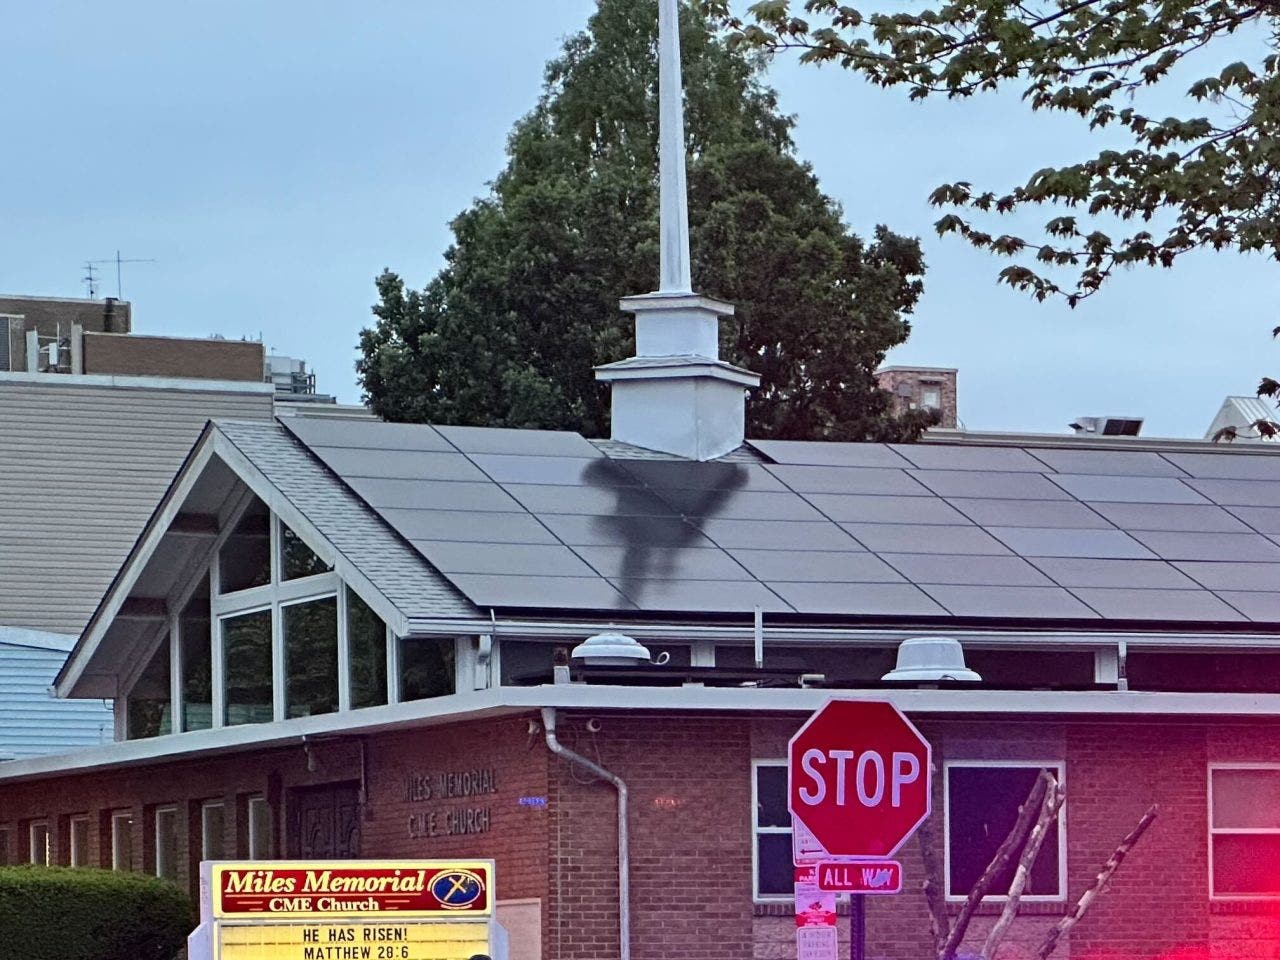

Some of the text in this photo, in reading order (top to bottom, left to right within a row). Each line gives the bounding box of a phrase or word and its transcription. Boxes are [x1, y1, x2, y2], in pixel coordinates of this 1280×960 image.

[440, 768, 498, 798] MEMORIAL
[798, 748, 920, 808] STOP
[445, 806, 492, 835] CHURCH
[225, 869, 426, 893] Miles Memorial
[823, 867, 852, 886] ALL
[268, 897, 380, 912] CME Church
[303, 927, 408, 942] HE HAS RISEN!
[304, 946, 409, 960] MATTHEW 28:6
